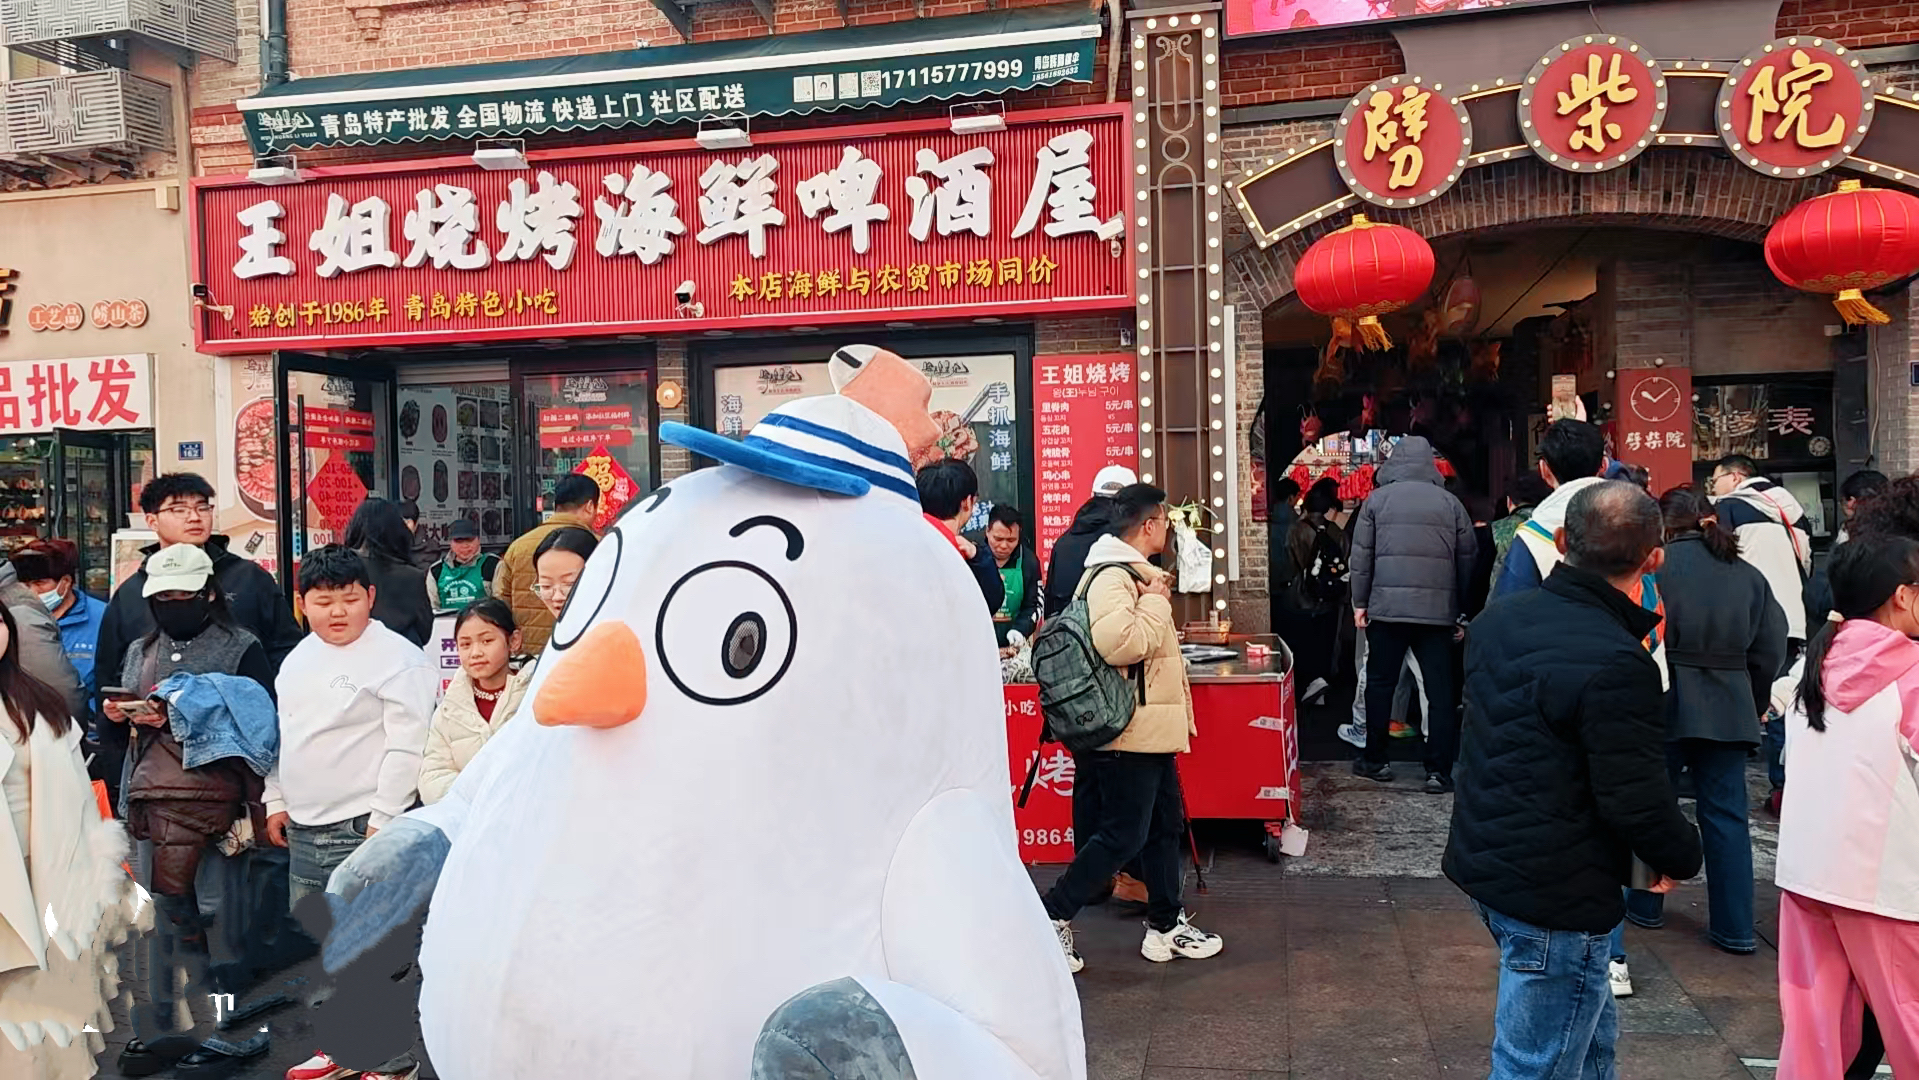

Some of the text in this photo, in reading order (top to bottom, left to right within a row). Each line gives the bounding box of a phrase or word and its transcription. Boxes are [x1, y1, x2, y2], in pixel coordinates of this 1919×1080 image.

[882, 59, 1023, 90] 17115777999
[320, 84, 746, 138] 青岛特产批发 全国物流 快递上门 社区配送
[232, 129, 1101, 279] 王姐烧烤海鲜啤酒屋
[729, 255, 1059, 301] 本店海鲜与农贸市场同价
[33, 310, 80, 325] 工艺品
[93, 305, 142, 322] 崂山茶
[248, 288, 559, 329] 始创于1986年 青岛特色小吃
[1040, 362, 1131, 385] 王姐烧烤
[721, 394, 742, 437] 海鲜
[1105, 400, 1133, 410] 5元/串
[988, 382, 1012, 472] 手抓海鲜
[1042, 425, 1070, 435] 五花肉
[1105, 423, 1133, 433] 5元/串
[1105, 445, 1134, 456] 5元/串
[1625, 431, 1686, 451] 劈柴院
[1003, 699, 1037, 716] 小吃
